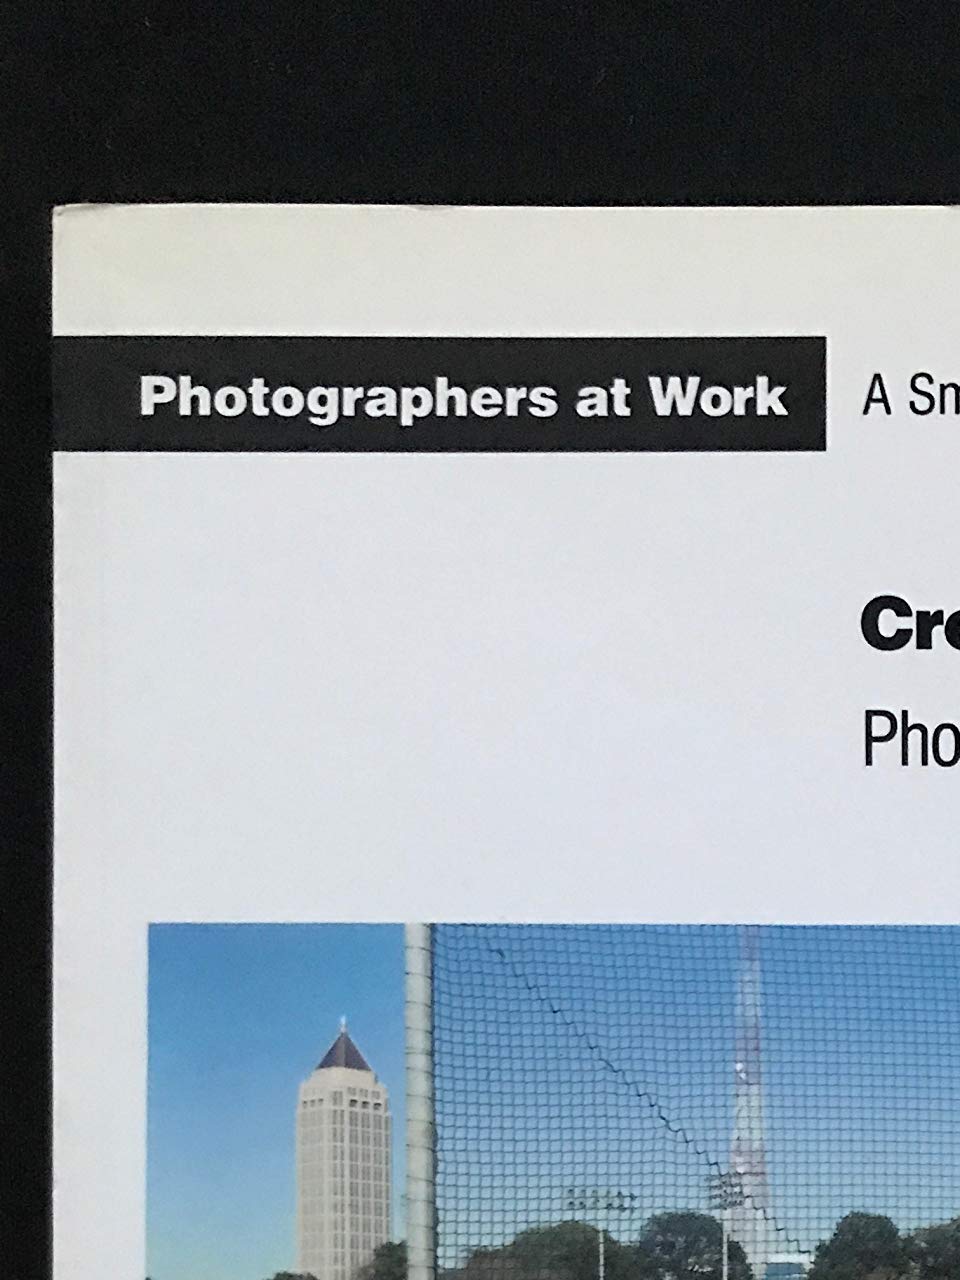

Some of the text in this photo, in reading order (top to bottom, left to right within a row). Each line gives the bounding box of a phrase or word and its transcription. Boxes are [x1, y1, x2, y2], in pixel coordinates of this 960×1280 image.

[140, 375, 789, 427] Photographers at Work
[863, 373, 892, 416] A
